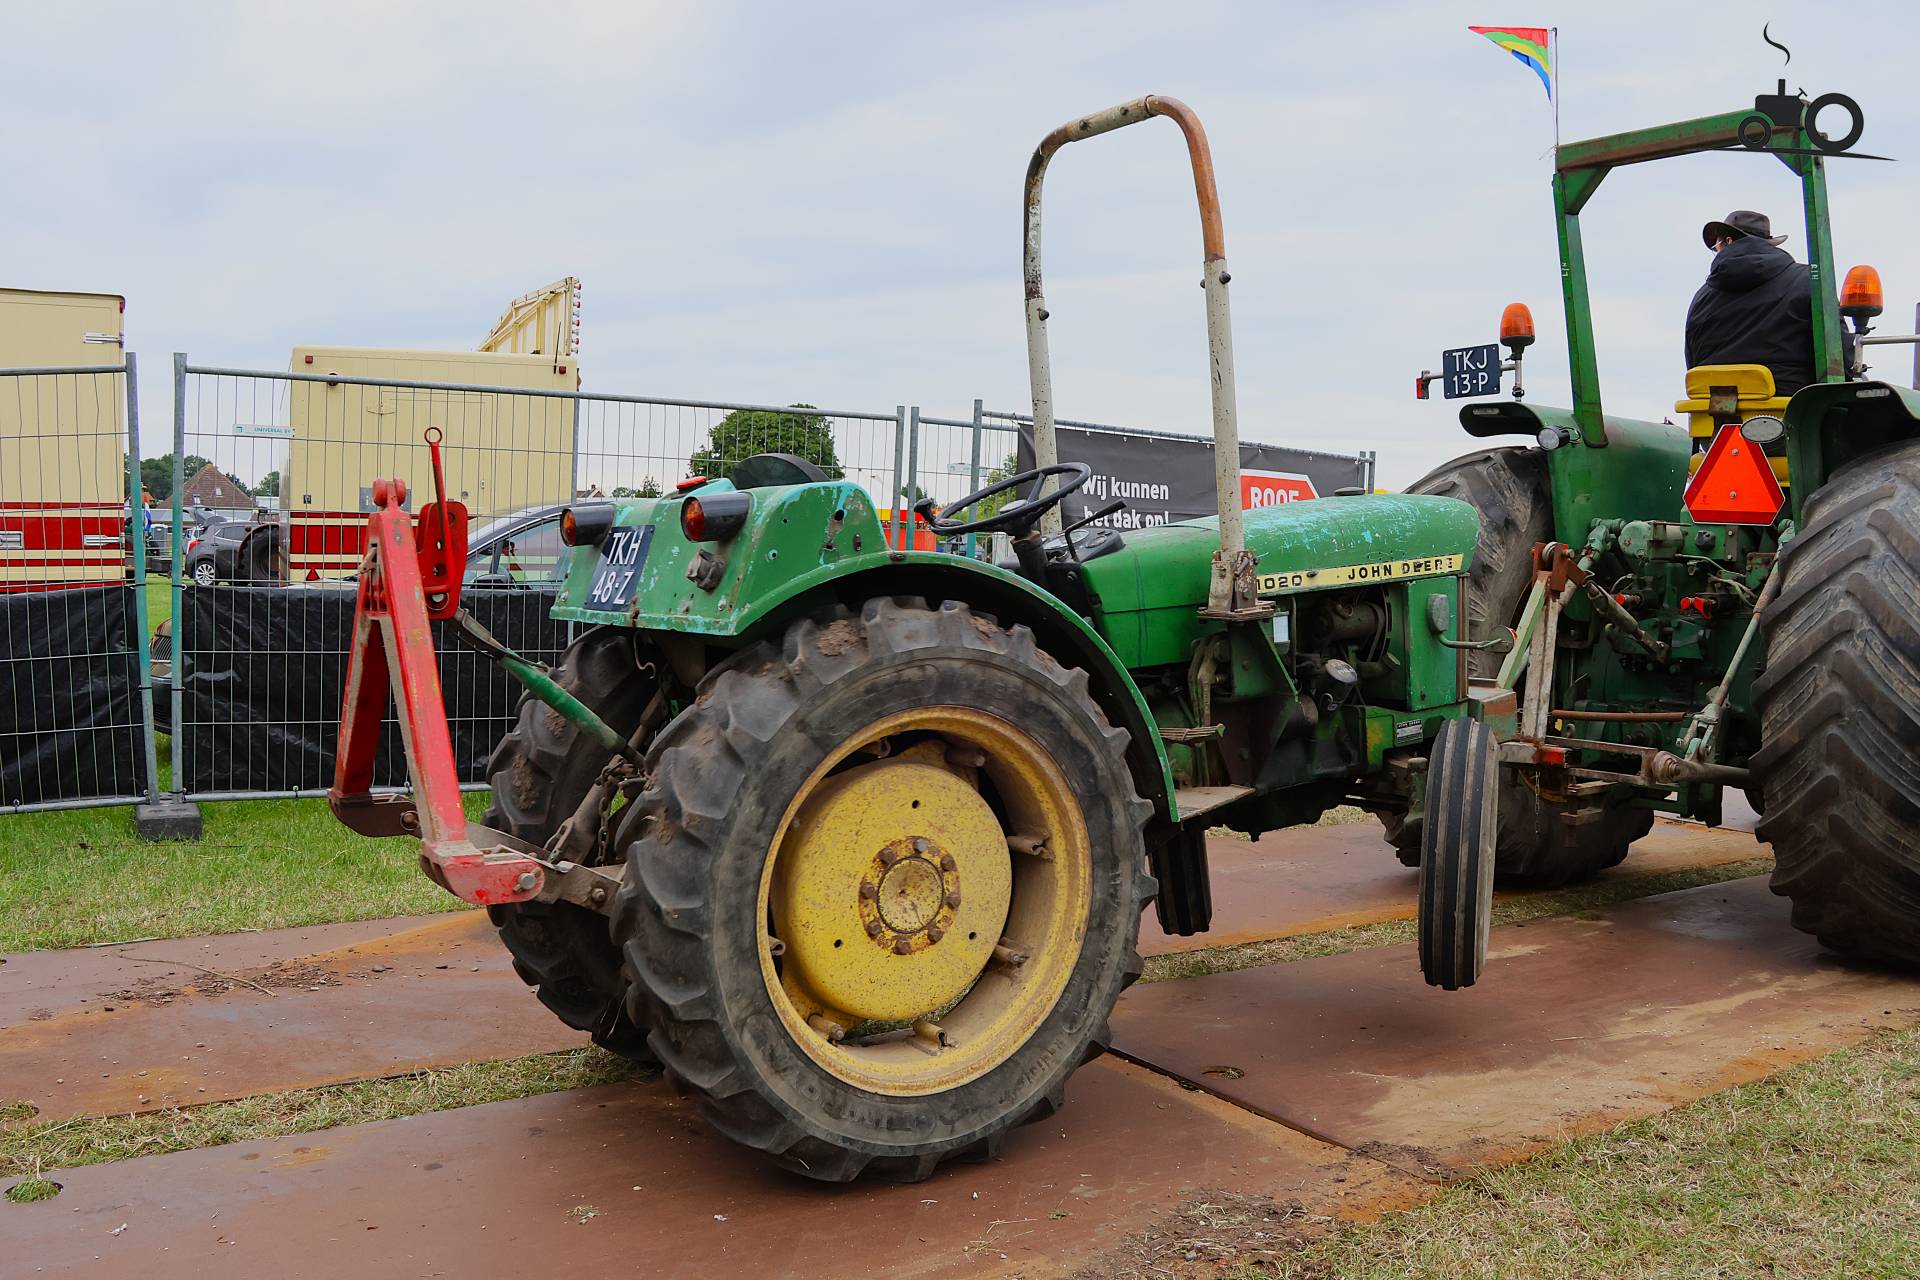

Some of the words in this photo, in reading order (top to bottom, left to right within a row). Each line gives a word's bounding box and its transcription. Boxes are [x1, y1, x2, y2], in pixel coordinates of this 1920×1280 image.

[1452, 349, 1488, 372] TKJ
[1453, 372, 1488, 395] 13-P
[1082, 475, 1107, 501] Wij
[1111, 476, 1169, 500] kunnen
[1112, 508, 1141, 528] dak
[606, 531, 644, 565] TKH
[592, 570, 635, 605] 48-Z
[1256, 574, 1302, 590] 1020
[1348, 564, 1392, 580] JOHN
